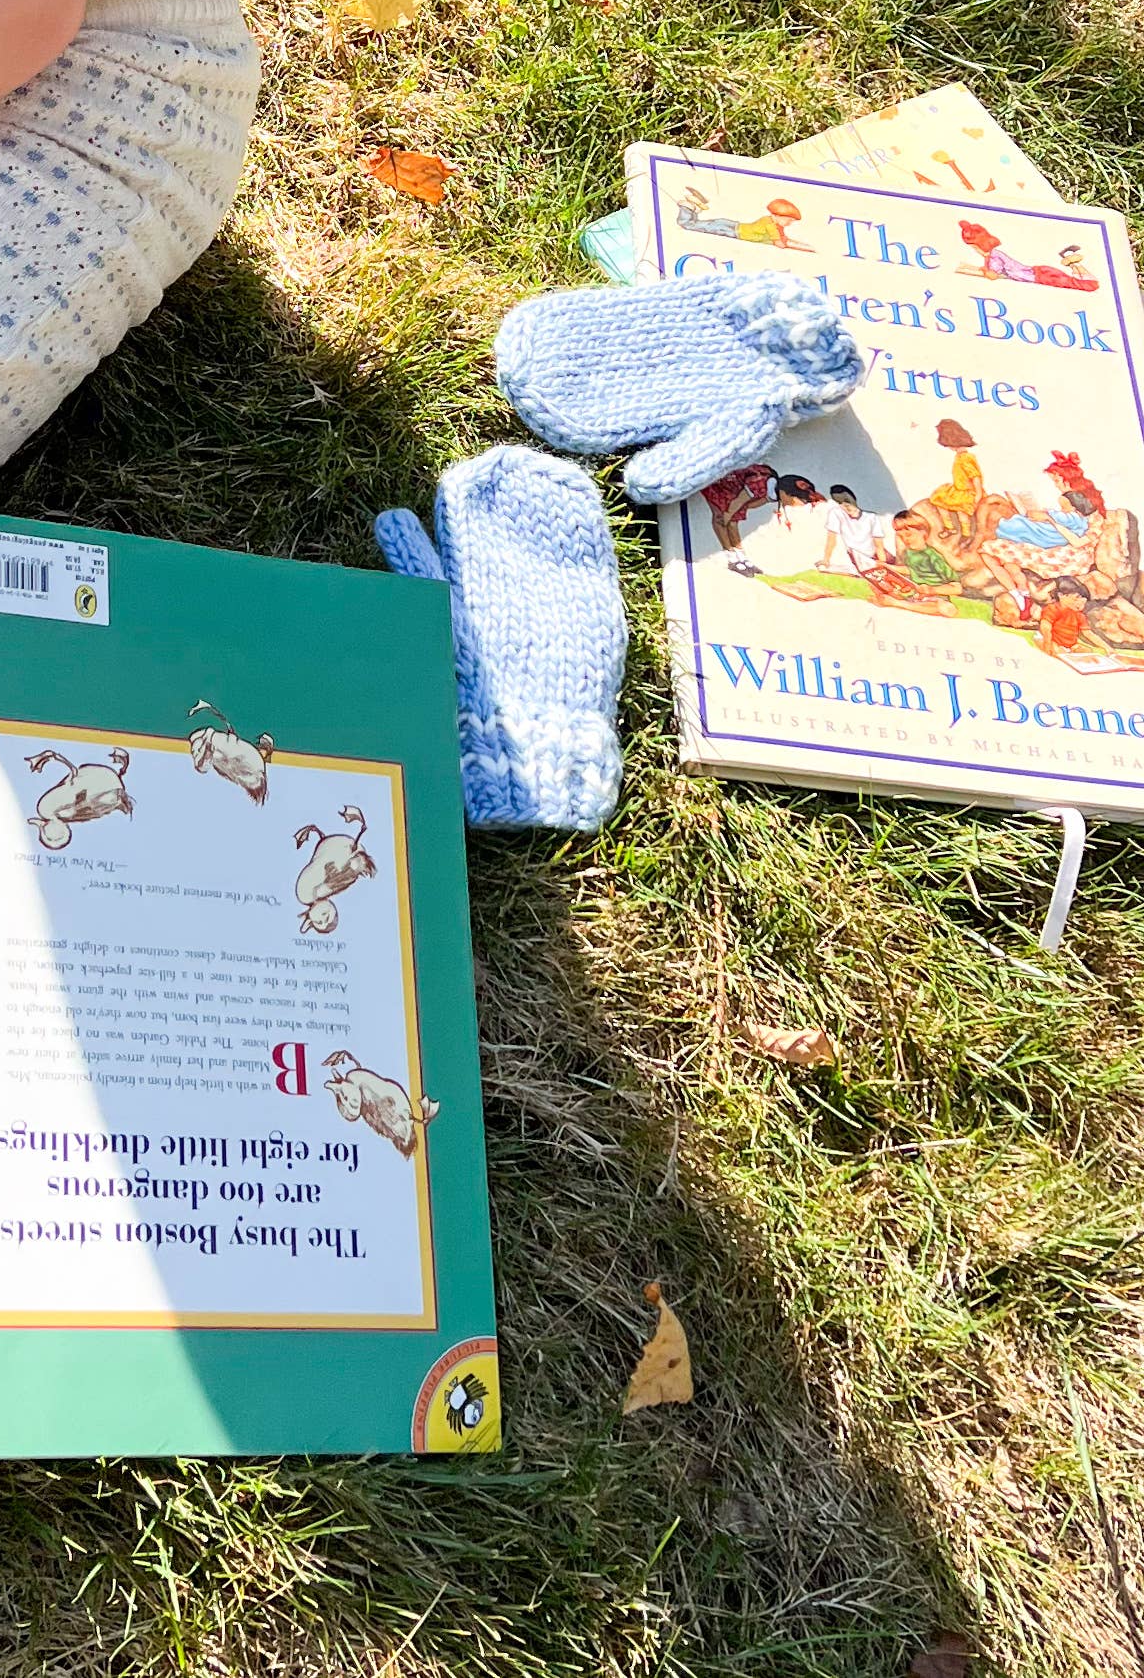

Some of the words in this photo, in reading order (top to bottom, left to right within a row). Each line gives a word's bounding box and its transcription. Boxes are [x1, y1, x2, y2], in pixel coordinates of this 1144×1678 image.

[828, 215, 941, 270] The
[969, 295, 1118, 353] Book
[876, 639, 976, 664] EDITED
[994, 655, 1024, 670] BY
[706, 642, 933, 713] William
[940, 672, 978, 729] J.
[722, 707, 909, 741] ILLUSTRATED
[927, 733, 955, 747] BY
[973, 738, 1095, 764] MICHAEL
[47, 855, 68, 869] York
[71, 857, 93, 870] New
[73, 940, 108, 955] delight
[114, 945, 124, 954] to
[292, 938, 334, 950] children.
[337, 941, 346, 951] of
[130, 946, 179, 958] continues
[185, 950, 215, 962] classic
[221, 951, 295, 969] Medal-winning
[80, 964, 132, 977] paperback
[301, 960, 347, 974] Caldecott
[182, 971, 188, 979] a
[194, 972, 204, 982] in
[210, 973, 232, 984] time
[238, 975, 257, 986] first
[263, 978, 278, 989] the
[285, 979, 297, 990] for
[303, 980, 347, 994] Available
[78, 985, 103, 997] giant
[110, 988, 127, 1000] the
[134, 990, 156, 1001] with
[163, 991, 189, 1002] swim
[195, 993, 213, 1004] and
[220, 995, 253, 1006] crowds
[301, 1000, 317, 1012] the
[324, 1002, 349, 1014] brave
[66, 1007, 82, 1018] old
[87, 1008, 121, 1021] they're
[125, 1011, 147, 1019] now
[151, 1011, 167, 1023] but
[203, 1016, 221, 1026] first
[225, 1016, 247, 1025] were
[251, 1017, 272, 1028] they
[276, 1020, 302, 1031] when
[51, 1026, 79, 1040] place
[86, 1030, 99, 1038] no
[306, 1021, 350, 1035] ducklings
[106, 1031, 124, 1039] was
[131, 1032, 169, 1045] Garden
[176, 1035, 206, 1048] Public
[213, 1037, 233, 1049] The
[82, 1050, 110, 1063] safely
[115, 1053, 144, 1064] arrive
[151, 1054, 181, 1068] family
[187, 1057, 203, 1070] her
[209, 1057, 227, 1069] and
[232, 1059, 271, 1073] Mallard
[96, 1072, 135, 1088] friendly
[139, 1077, 144, 1085] a
[147, 1077, 171, 1089] from
[175, 1076, 197, 1090] help
[200, 1079, 224, 1092] little
[237, 1082, 258, 1093] with
[160, 1136, 229, 1168] little
[240, 1130, 309, 1169] eight
[319, 1143, 359, 1172] for
[47, 1168, 208, 1209] dangerous
[219, 1181, 263, 1208] too
[275, 1182, 321, 1206] are
[0, 1220, 103, 1249] streets
[114, 1222, 217, 1254] Boston
[229, 1216, 297, 1256] busy
[308, 1227, 366, 1258] The
